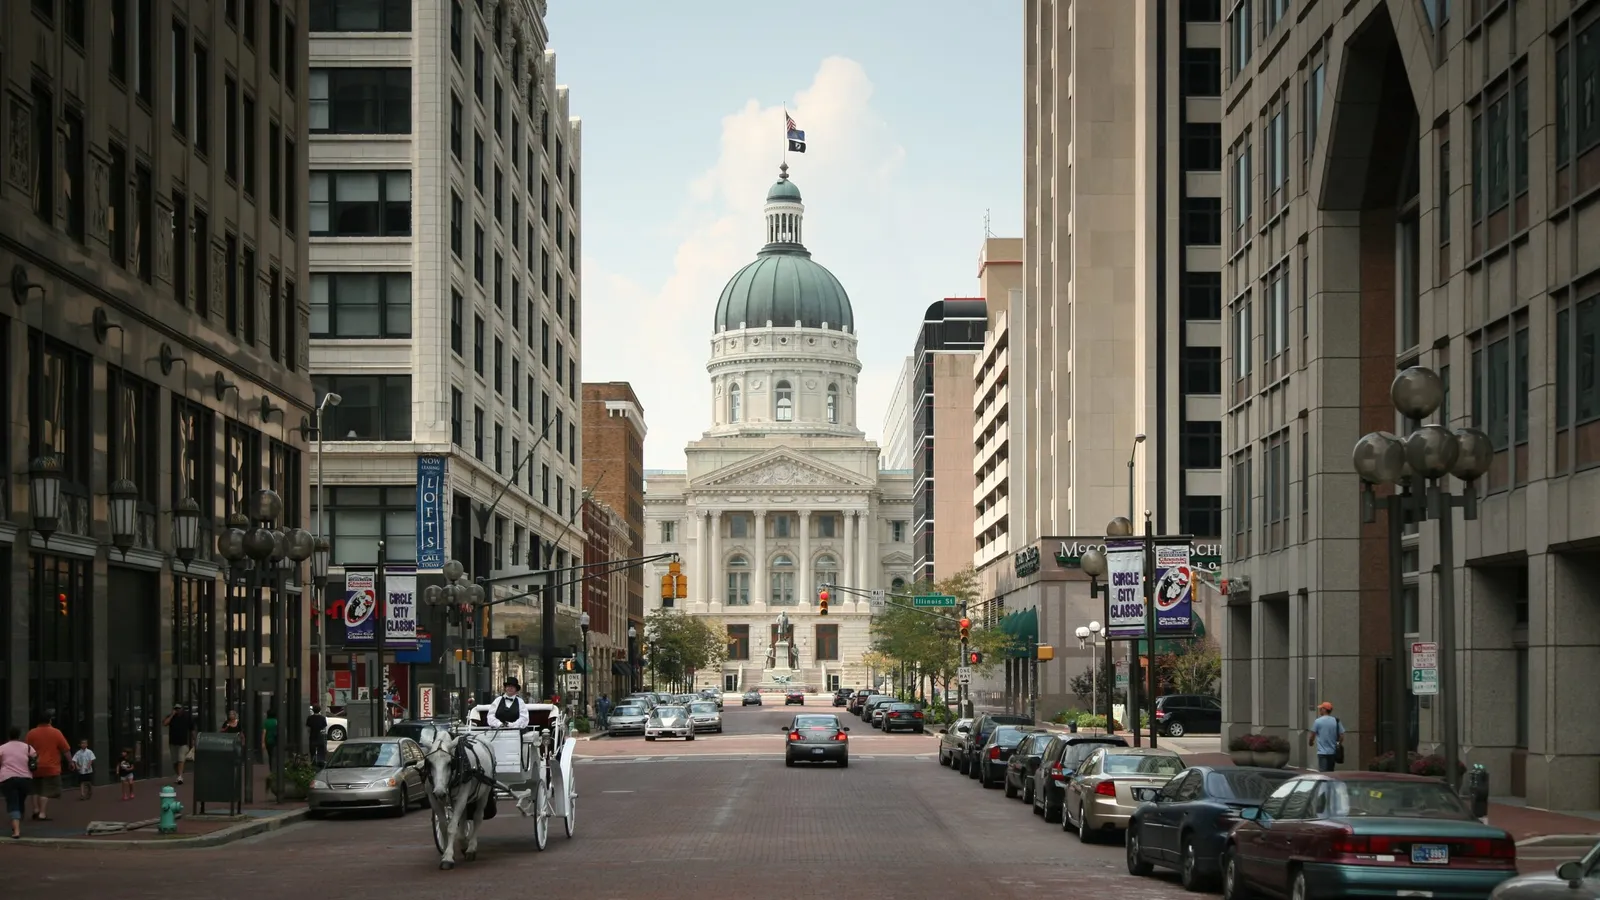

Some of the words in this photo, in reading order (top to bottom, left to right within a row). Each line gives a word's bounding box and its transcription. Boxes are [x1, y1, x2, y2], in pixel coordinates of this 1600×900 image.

[421, 457, 440, 465] NOW
[423, 478, 435, 548] LOFTS
[1112, 572, 1139, 586] CIRCLE
[389, 593, 412, 605] CIRCLE
[1118, 588, 1135, 602] CITY
[393, 607, 409, 618] CITY
[1110, 604, 1143, 618] CLASSIC
[387, 620, 415, 631] CLASSIC
[1414, 670, 1421, 681] 2
